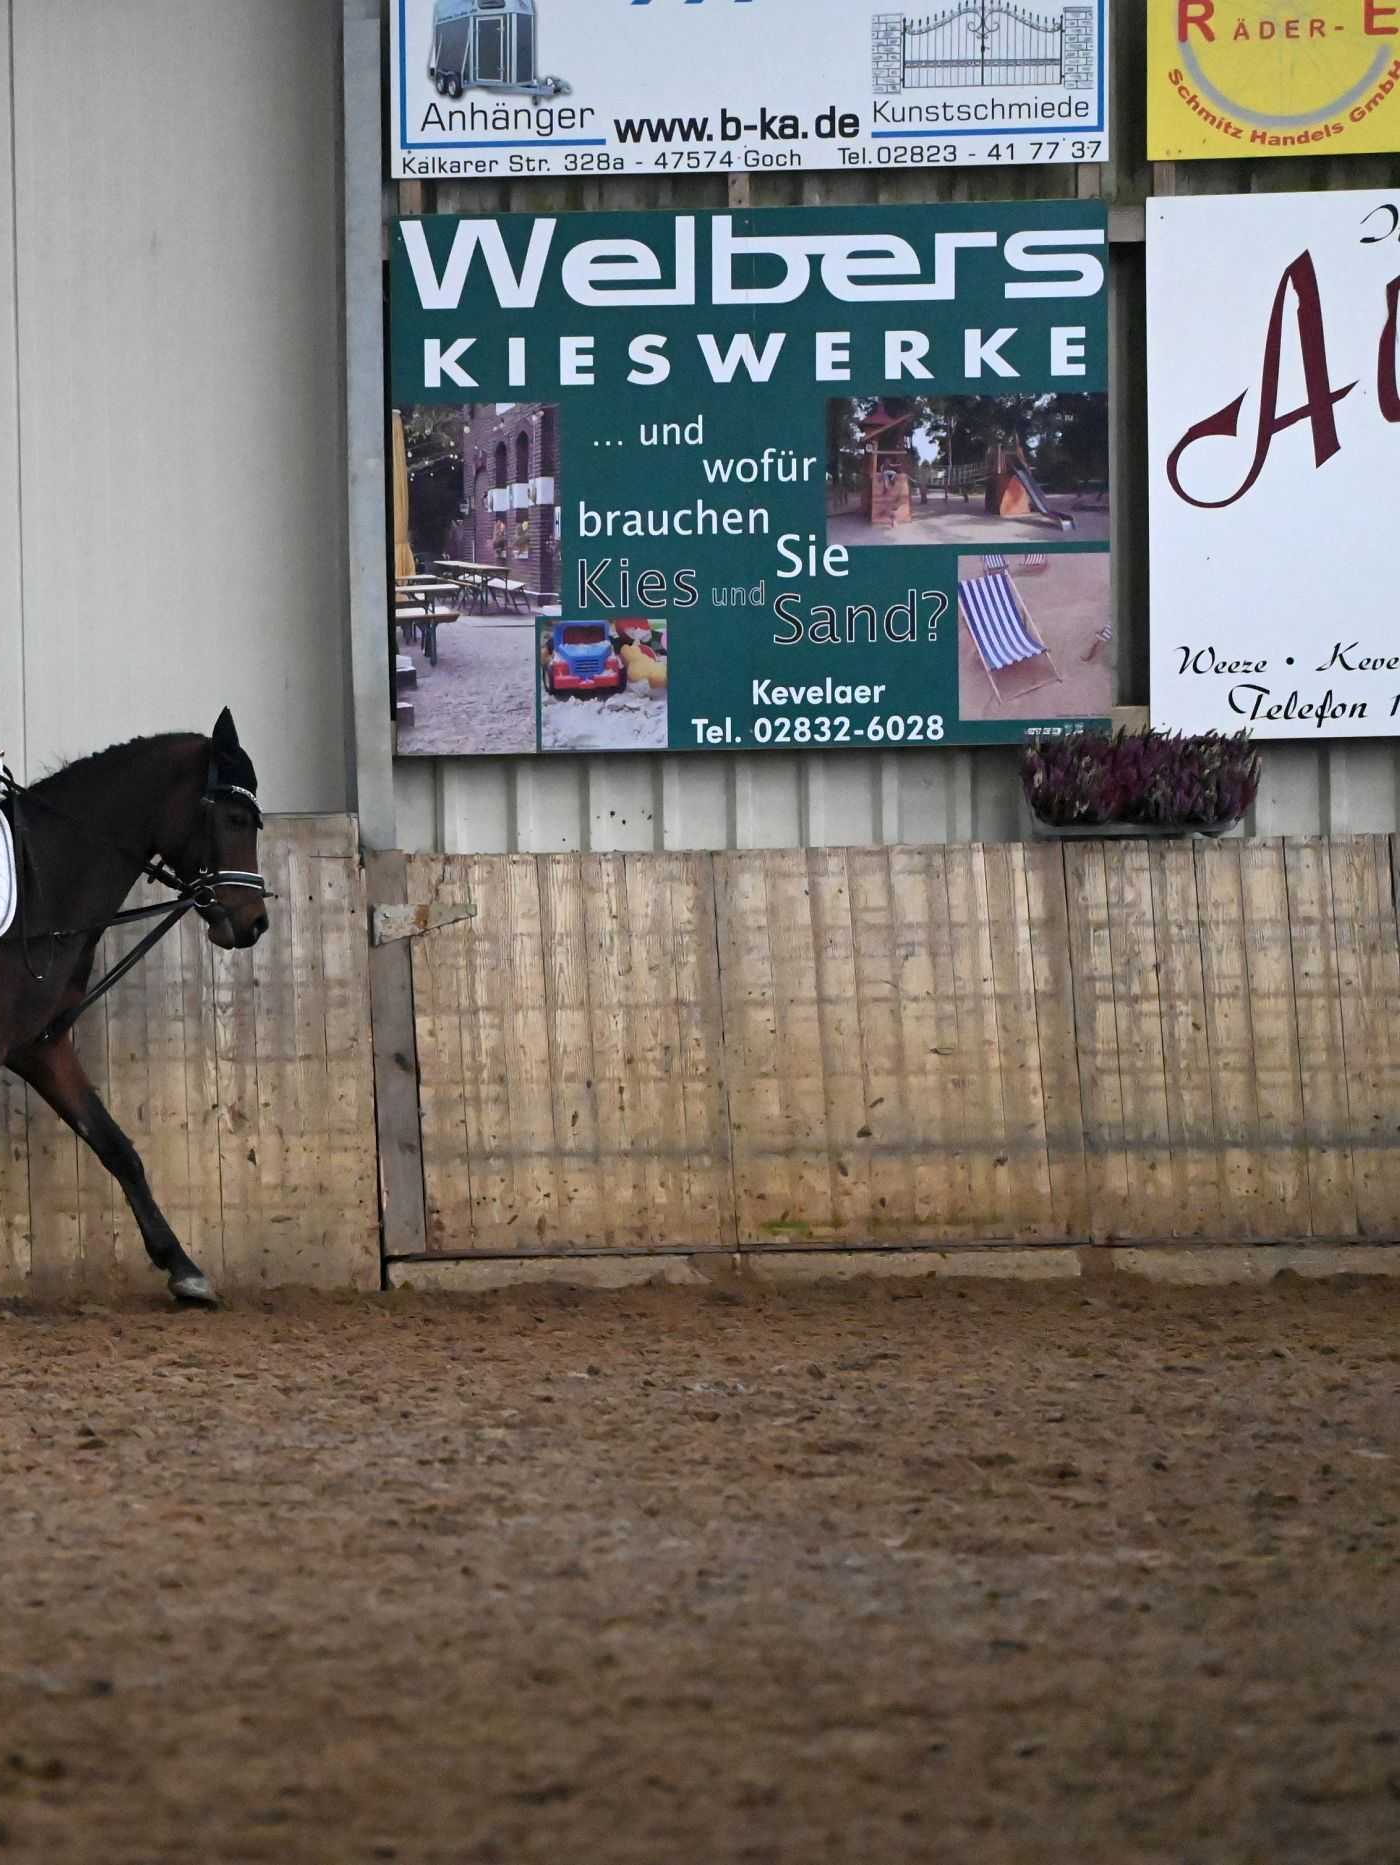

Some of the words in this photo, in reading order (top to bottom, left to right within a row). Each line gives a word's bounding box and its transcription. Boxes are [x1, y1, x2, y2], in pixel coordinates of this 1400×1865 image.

[420, 102, 595, 137] Anhänger
[614, 105, 860, 143] www.b-ka.de
[873, 96, 1089, 123] Kunstschmiede
[1168, 68, 1244, 139] Schmitz
[1250, 123, 1344, 146] Handels
[402, 156, 499, 174] Kalkarer
[509, 154, 550, 172] Str.
[564, 153, 624, 171] 328a
[654, 151, 734, 170] 47574
[744, 149, 801, 168] Goch
[399, 215, 1105, 309] Welbers
[424, 326, 1088, 388] KIESWERKE
[639, 415, 704, 446] und
[703, 448, 817, 483] wofür
[578, 500, 770, 538] brauchen
[776, 534, 849, 580] Sie
[577, 558, 700, 609] Kies
[711, 579, 766, 607] und
[772, 590, 950, 646] Sand?
[1174, 646, 1268, 675] Weeze
[752, 678, 886, 706] Kevelaer
[1228, 684, 1368, 728] Telefon
[692, 718, 742, 745] Tel.
[754, 715, 945, 744] 02832-6028
